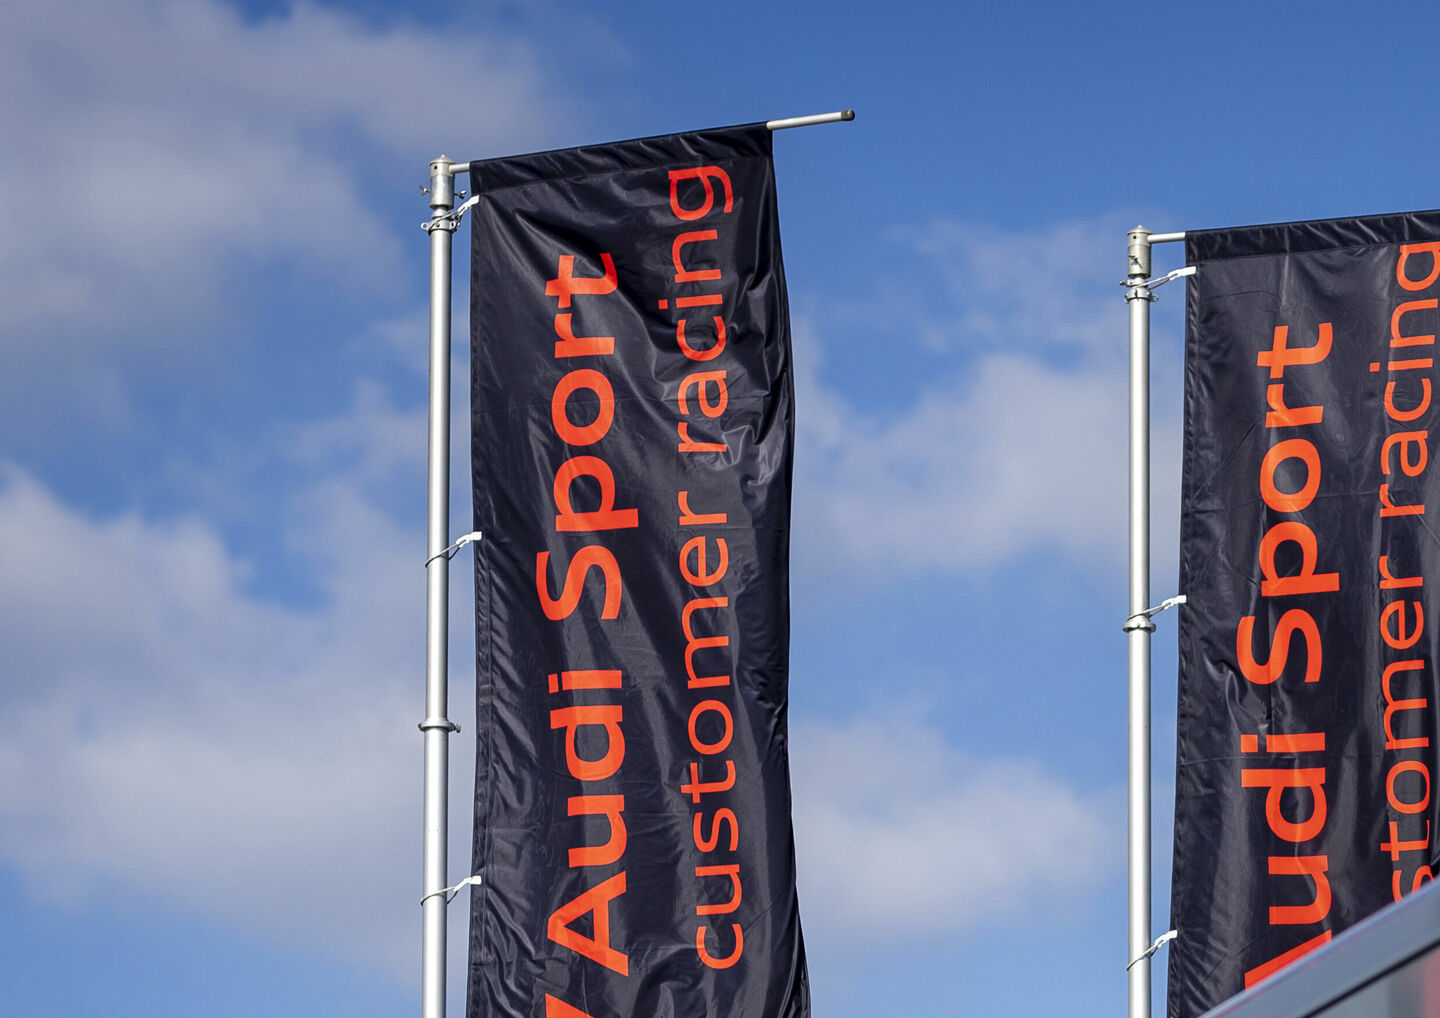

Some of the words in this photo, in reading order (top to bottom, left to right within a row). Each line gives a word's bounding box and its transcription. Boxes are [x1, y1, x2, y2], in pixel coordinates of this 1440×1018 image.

[536, 252, 639, 622] Sport
[658, 165, 734, 455] racing
[1237, 321, 1340, 684] Sport
[547, 669, 629, 977] Audi
[678, 490, 745, 970] customer
[1379, 554, 1436, 904] stomer
